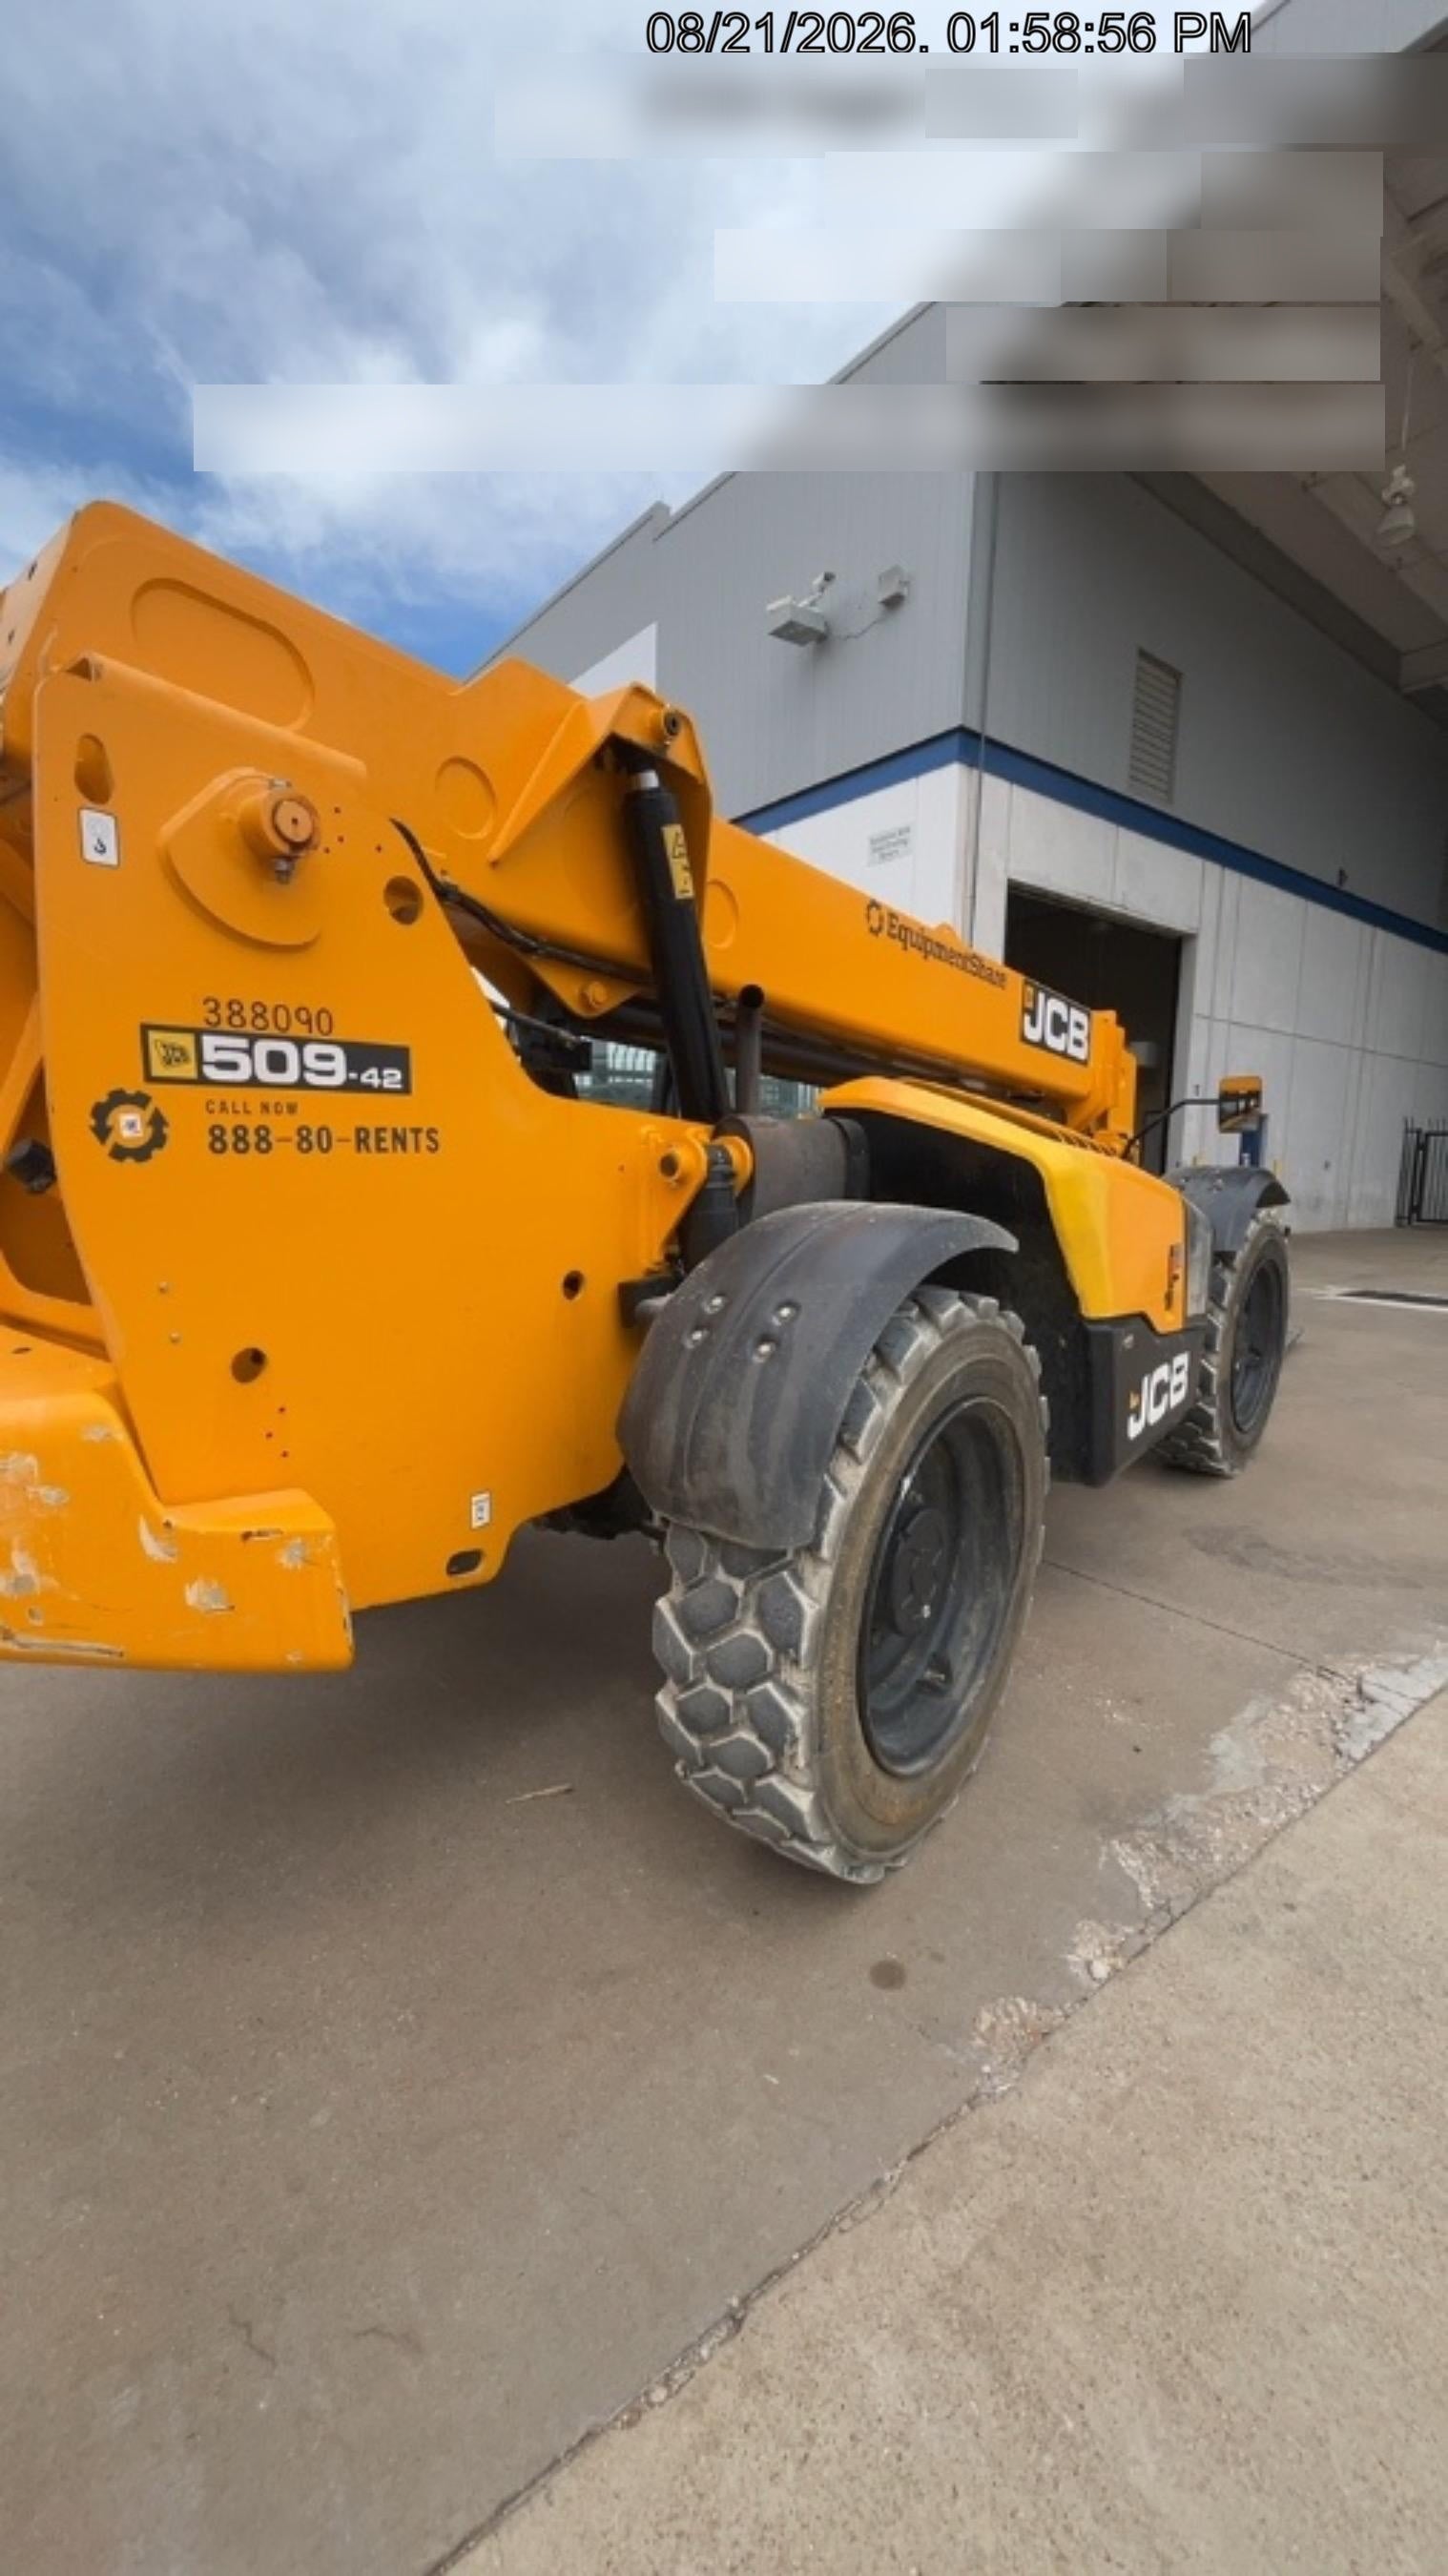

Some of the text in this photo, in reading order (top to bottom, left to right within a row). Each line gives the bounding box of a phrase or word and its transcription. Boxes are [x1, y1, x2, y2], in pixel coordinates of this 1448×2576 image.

[202, 997, 334, 1036] 388090
[1024, 987, 1090, 1063] JCB
[205, 1100, 299, 1115] CALL NOW
[208, 1123, 440, 1154] 888-80-RENTS
[1127, 1351, 1189, 1441] JCB
